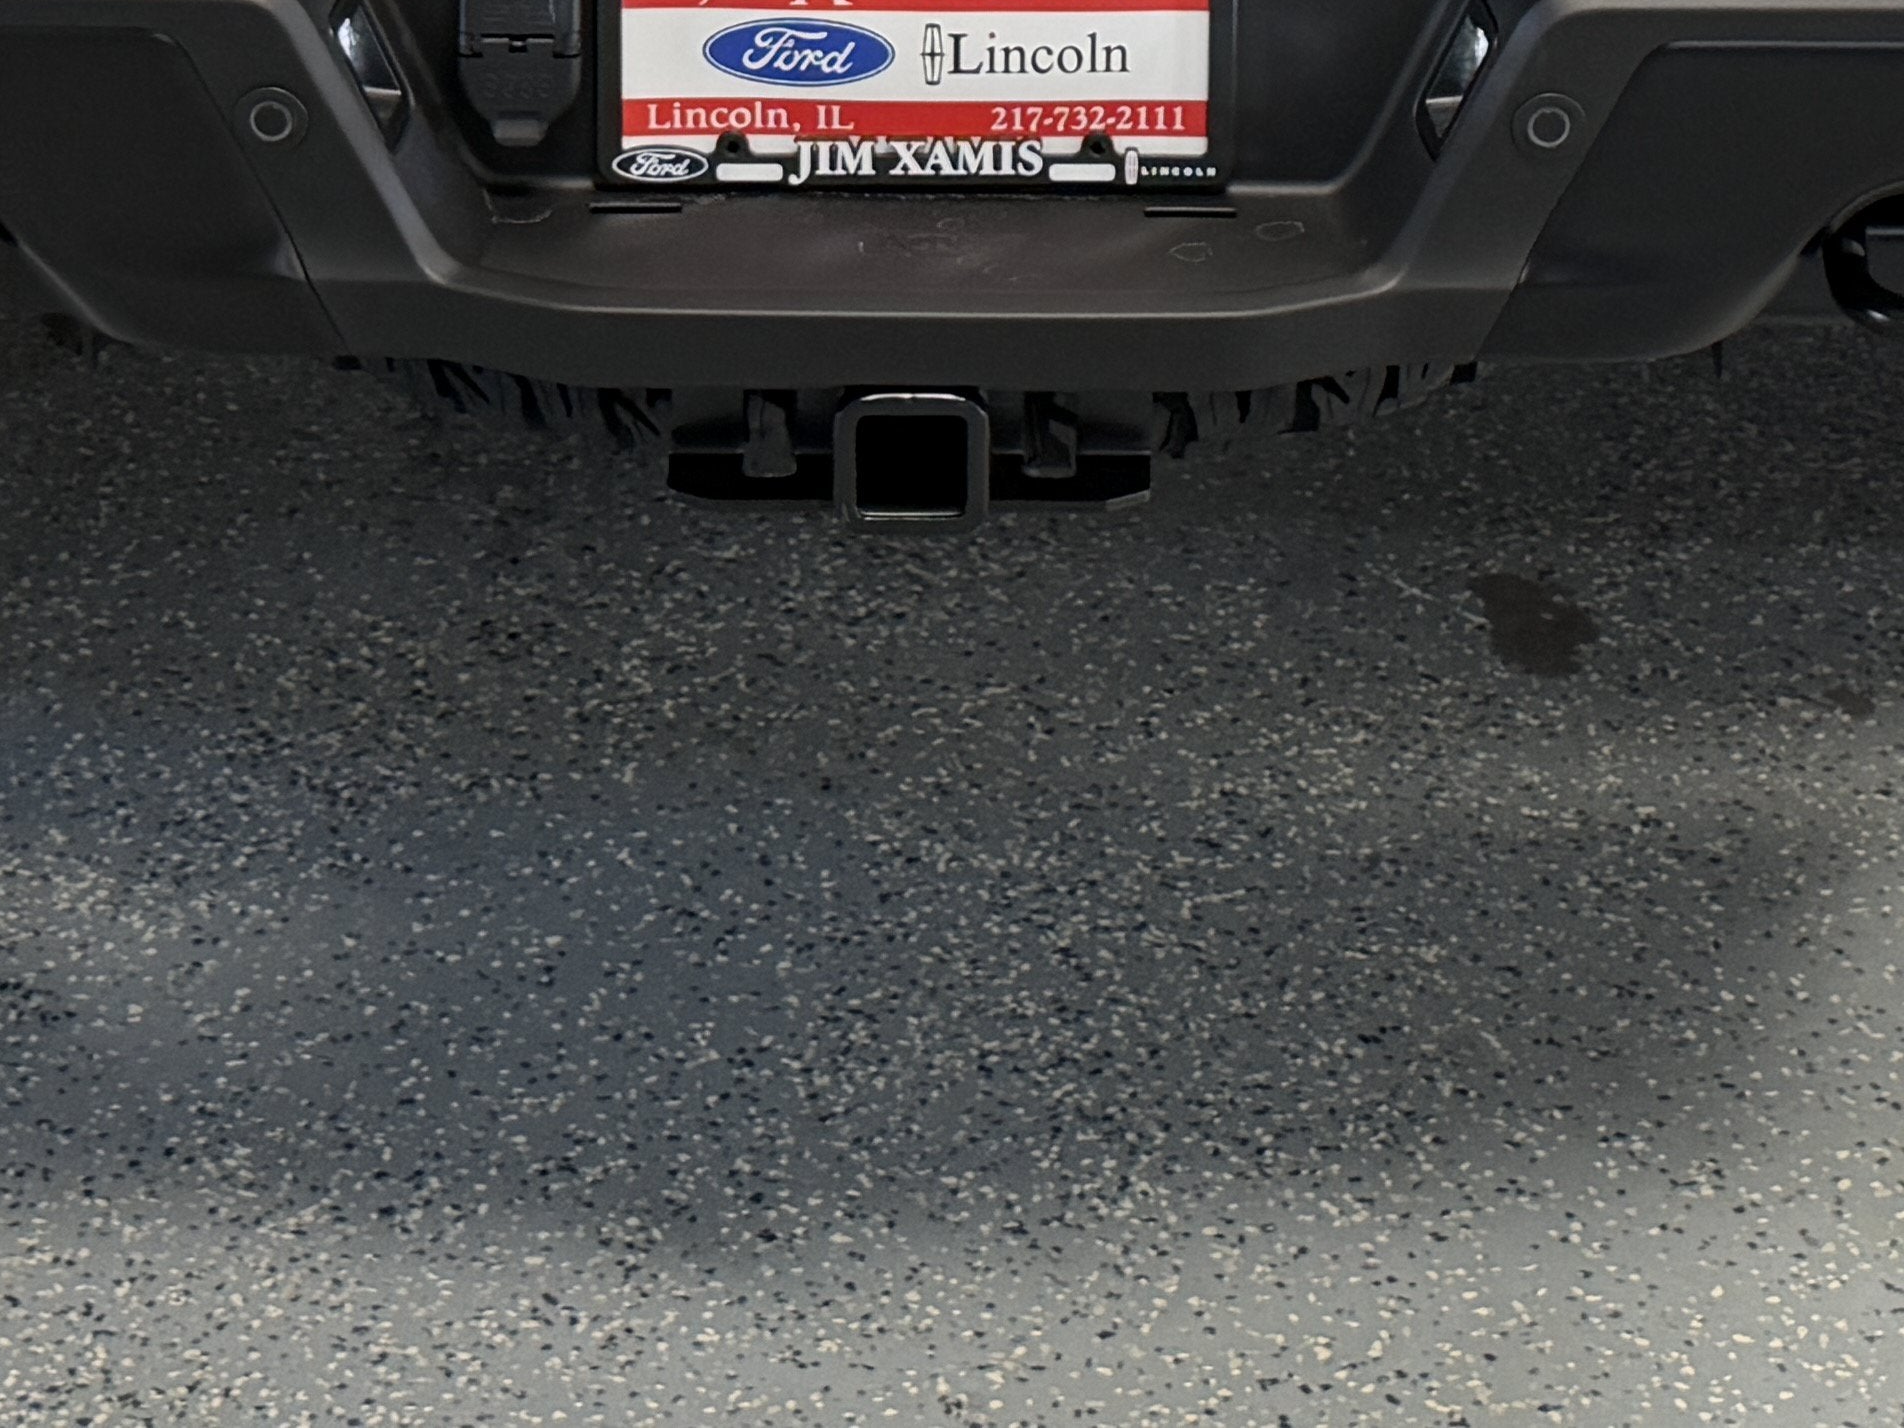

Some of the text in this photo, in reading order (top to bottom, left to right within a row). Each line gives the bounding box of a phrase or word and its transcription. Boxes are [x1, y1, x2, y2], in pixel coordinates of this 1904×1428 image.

[741, 27, 857, 73] Ford
[946, 31, 1130, 75] Lincoln
[647, 100, 855, 133] Lincoln, IL
[991, 106, 1185, 132] 217-732-2111
[630, 153, 692, 176] Ford
[788, 140, 1044, 185] JIM XAMIS
[1140, 166, 1217, 177] LINCOLN
